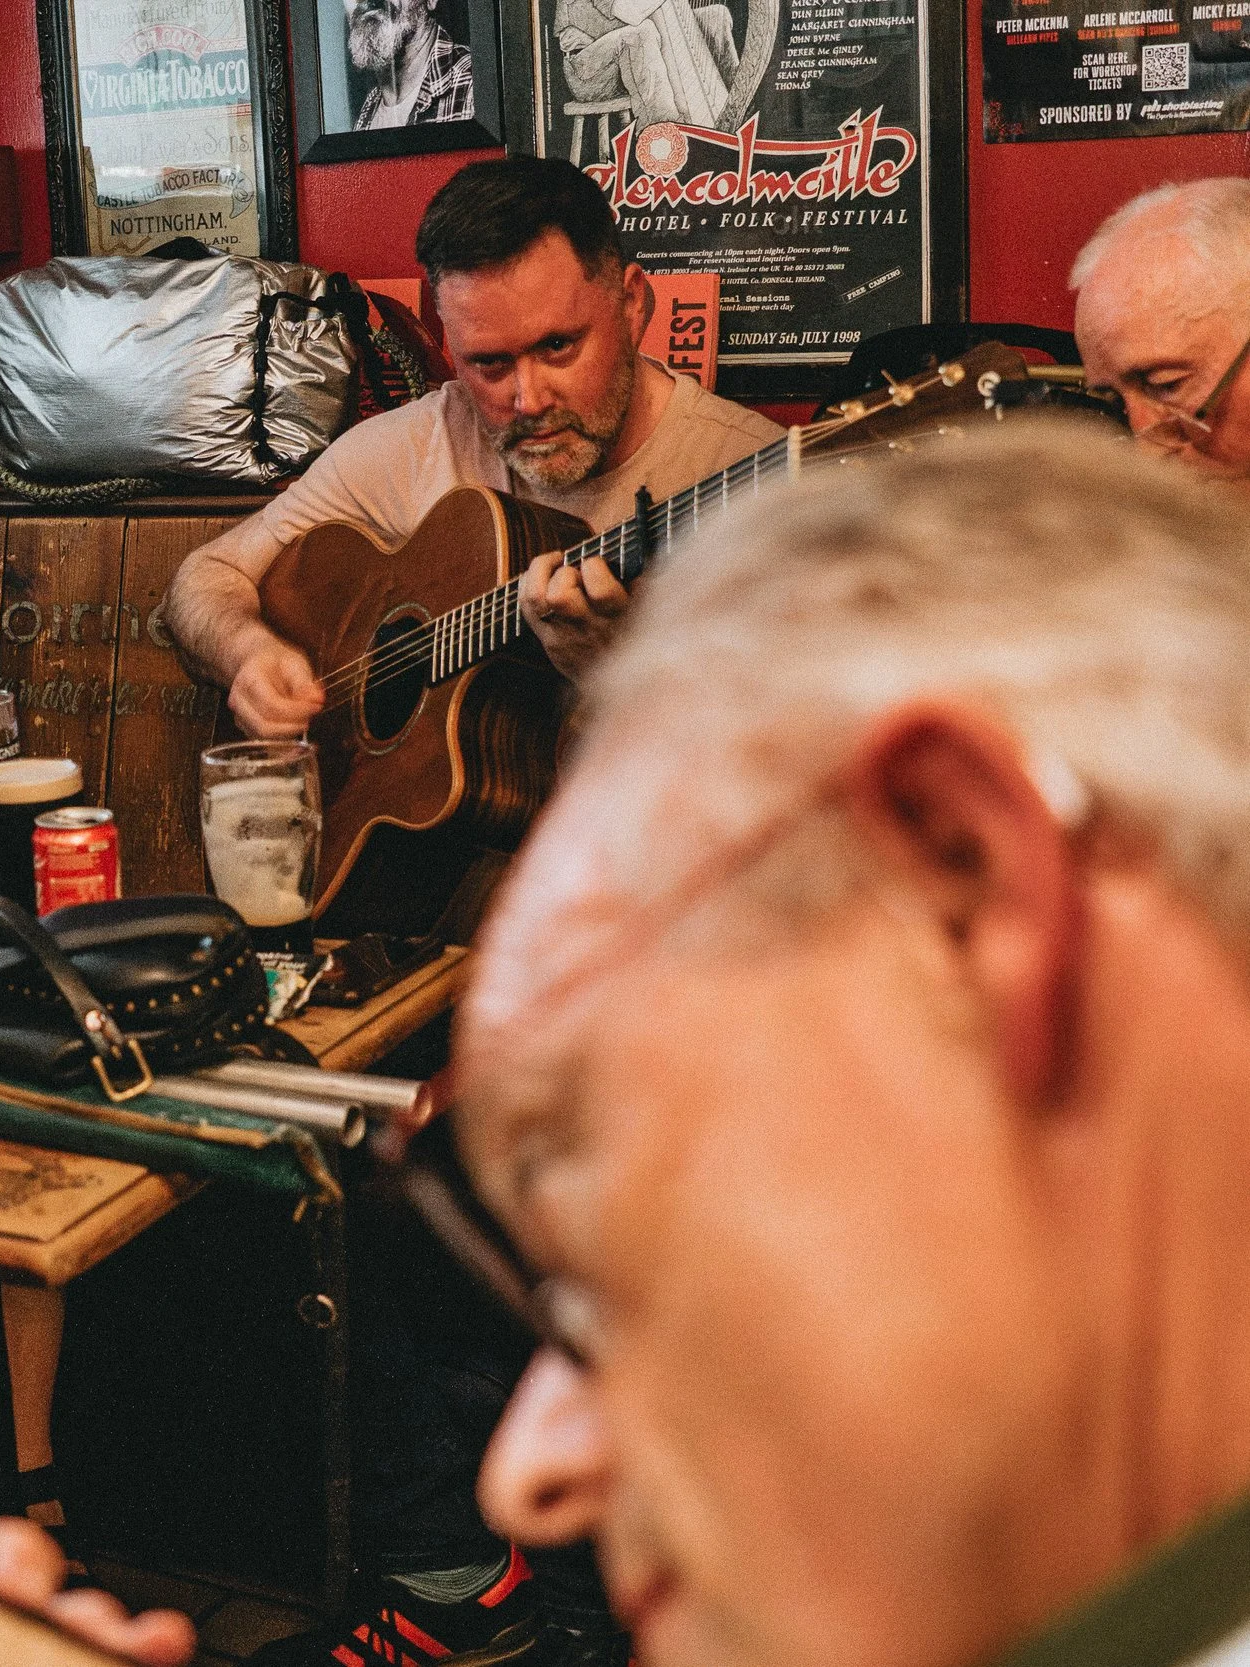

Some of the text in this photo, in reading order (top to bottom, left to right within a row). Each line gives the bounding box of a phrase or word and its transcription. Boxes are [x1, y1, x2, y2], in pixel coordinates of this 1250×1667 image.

[1083, 8, 1174, 28] ARLENE MCCARROLL
[1193, 2, 1250, 20] MICKY FEAR
[791, 16, 915, 32] MARGARET CUNNINGHAM
[996, 16, 1069, 34] PETER MCKENNA
[788, 33, 841, 45] JOHN BYRNE
[787, 47, 815, 57] DEREK
[832, 45, 863, 55] GINLEY
[780, 57, 877, 69] FRANCIS CUNNINGHAM
[1082, 52, 1128, 66] SCAN HERE
[777, 70, 824, 81] SEAN GREY
[1073, 64, 1137, 79] FOR WORKSHOP
[166, 57, 250, 104] TOBACCO
[775, 81, 811, 91] THOMAS
[1088, 78, 1122, 90] TICKETS
[1039, 103, 1133, 125] SPONSORED BY
[110, 212, 227, 236] NOTTINGHAM.
[622, 209, 908, 232] HOTEL FOLK FESTIVAL
[201, 235, 242, 245] LAND.
[636, 251, 668, 259] Concerts
[669, 249, 713, 258] commencing
[764, 247, 786, 256] night,
[787, 246, 811, 254] Doors
[812, 246, 830, 254] open
[762, 255, 796, 263] inquiries
[847, 269, 901, 300] FREE CAMPING
[746, 293, 791, 302] Sessions
[736, 304, 760, 312] lounge
[780, 303, 795, 312] day
[728, 331, 861, 346] SUNDAY 5th JULY 1998
